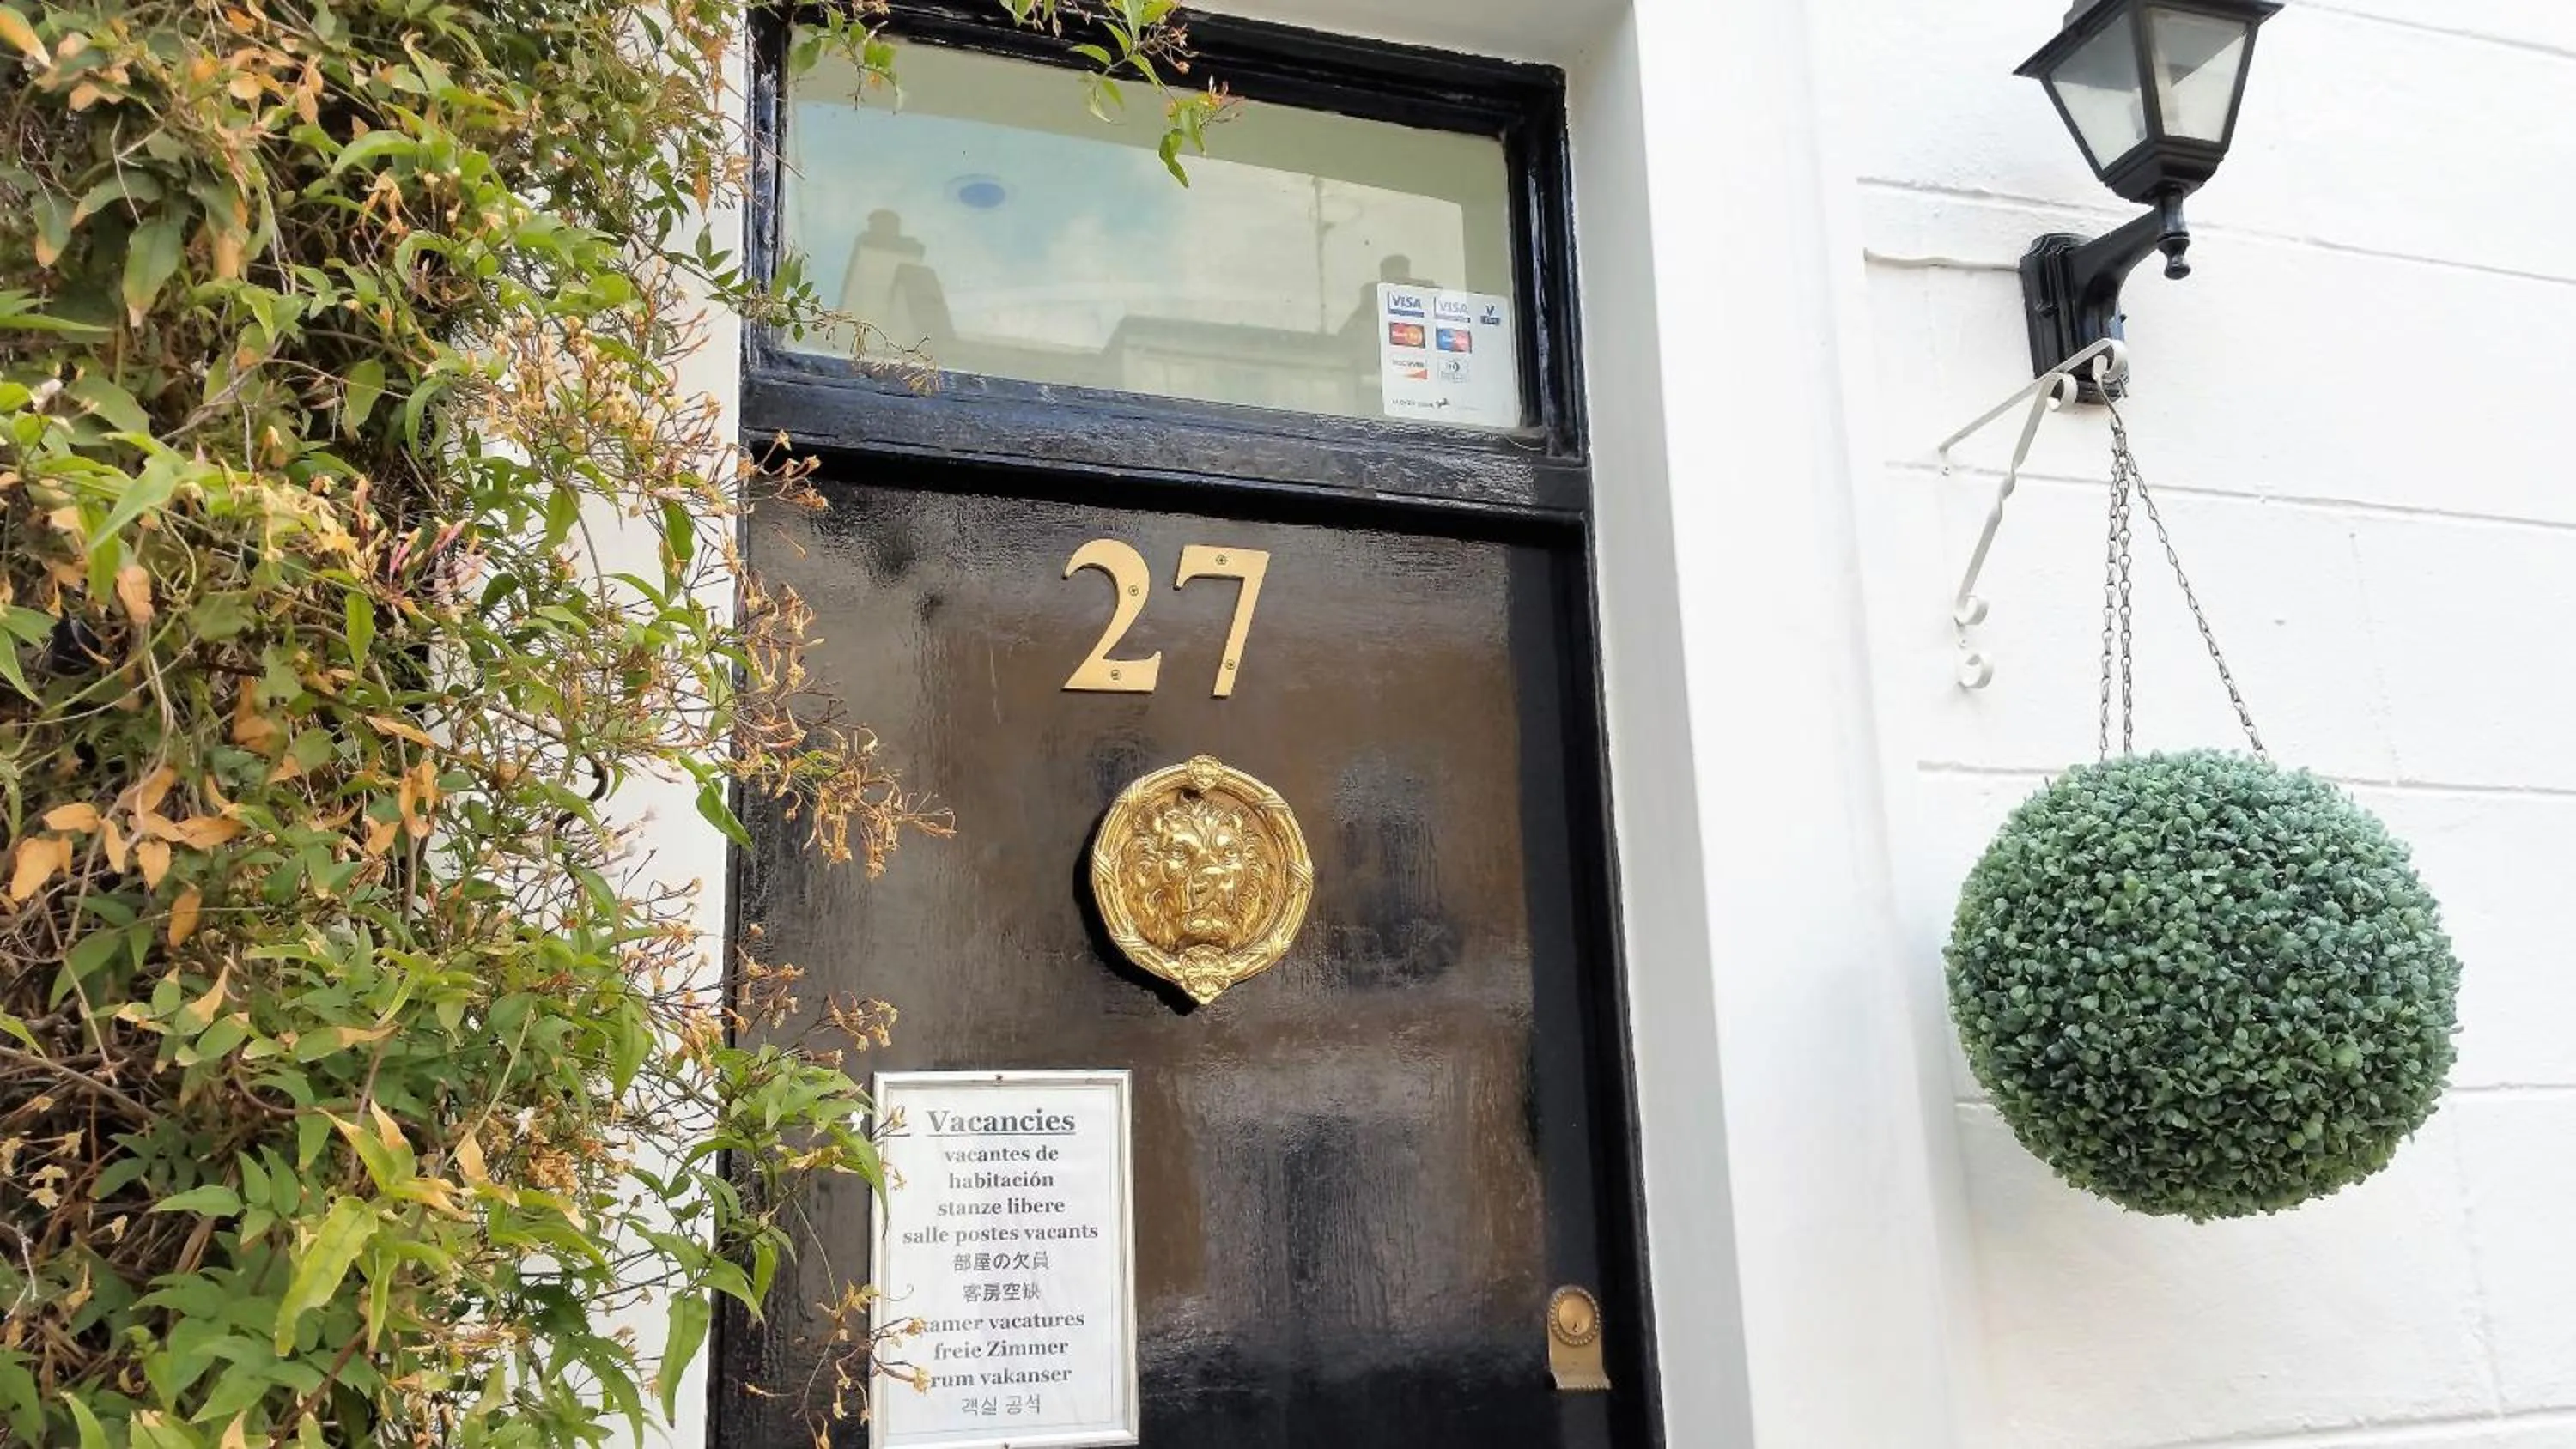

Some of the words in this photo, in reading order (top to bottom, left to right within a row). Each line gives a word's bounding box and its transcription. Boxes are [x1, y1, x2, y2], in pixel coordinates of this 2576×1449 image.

[1392, 294, 1422, 308] VISA
[1439, 301, 1469, 314] VISA
[1063, 537, 1271, 697] 27
[927, 1108, 1075, 1132] Vacancies
[945, 1147, 1030, 1162] vacantes
[1036, 1145, 1059, 1161] de
[949, 1171, 1054, 1189] habitación
[937, 1201, 1002, 1216] stanze
[1007, 1198, 1066, 1214] libere
[902, 1227, 949, 1244] salle
[955, 1227, 1019, 1246] postes
[1024, 1223, 1099, 1240] vacants
[953, 1251, 1049, 1272] 部屋の欠員
[963, 1282, 1042, 1302] 客房空缺
[988, 1313, 1085, 1329] vacatures
[933, 1342, 982, 1360] freie
[987, 1340, 1069, 1357] Zimmer
[930, 1374, 975, 1388] rum
[980, 1368, 1073, 1385] vakanser
[961, 1397, 998, 1416] 객실
[1005, 1394, 1042, 1416] 공석
